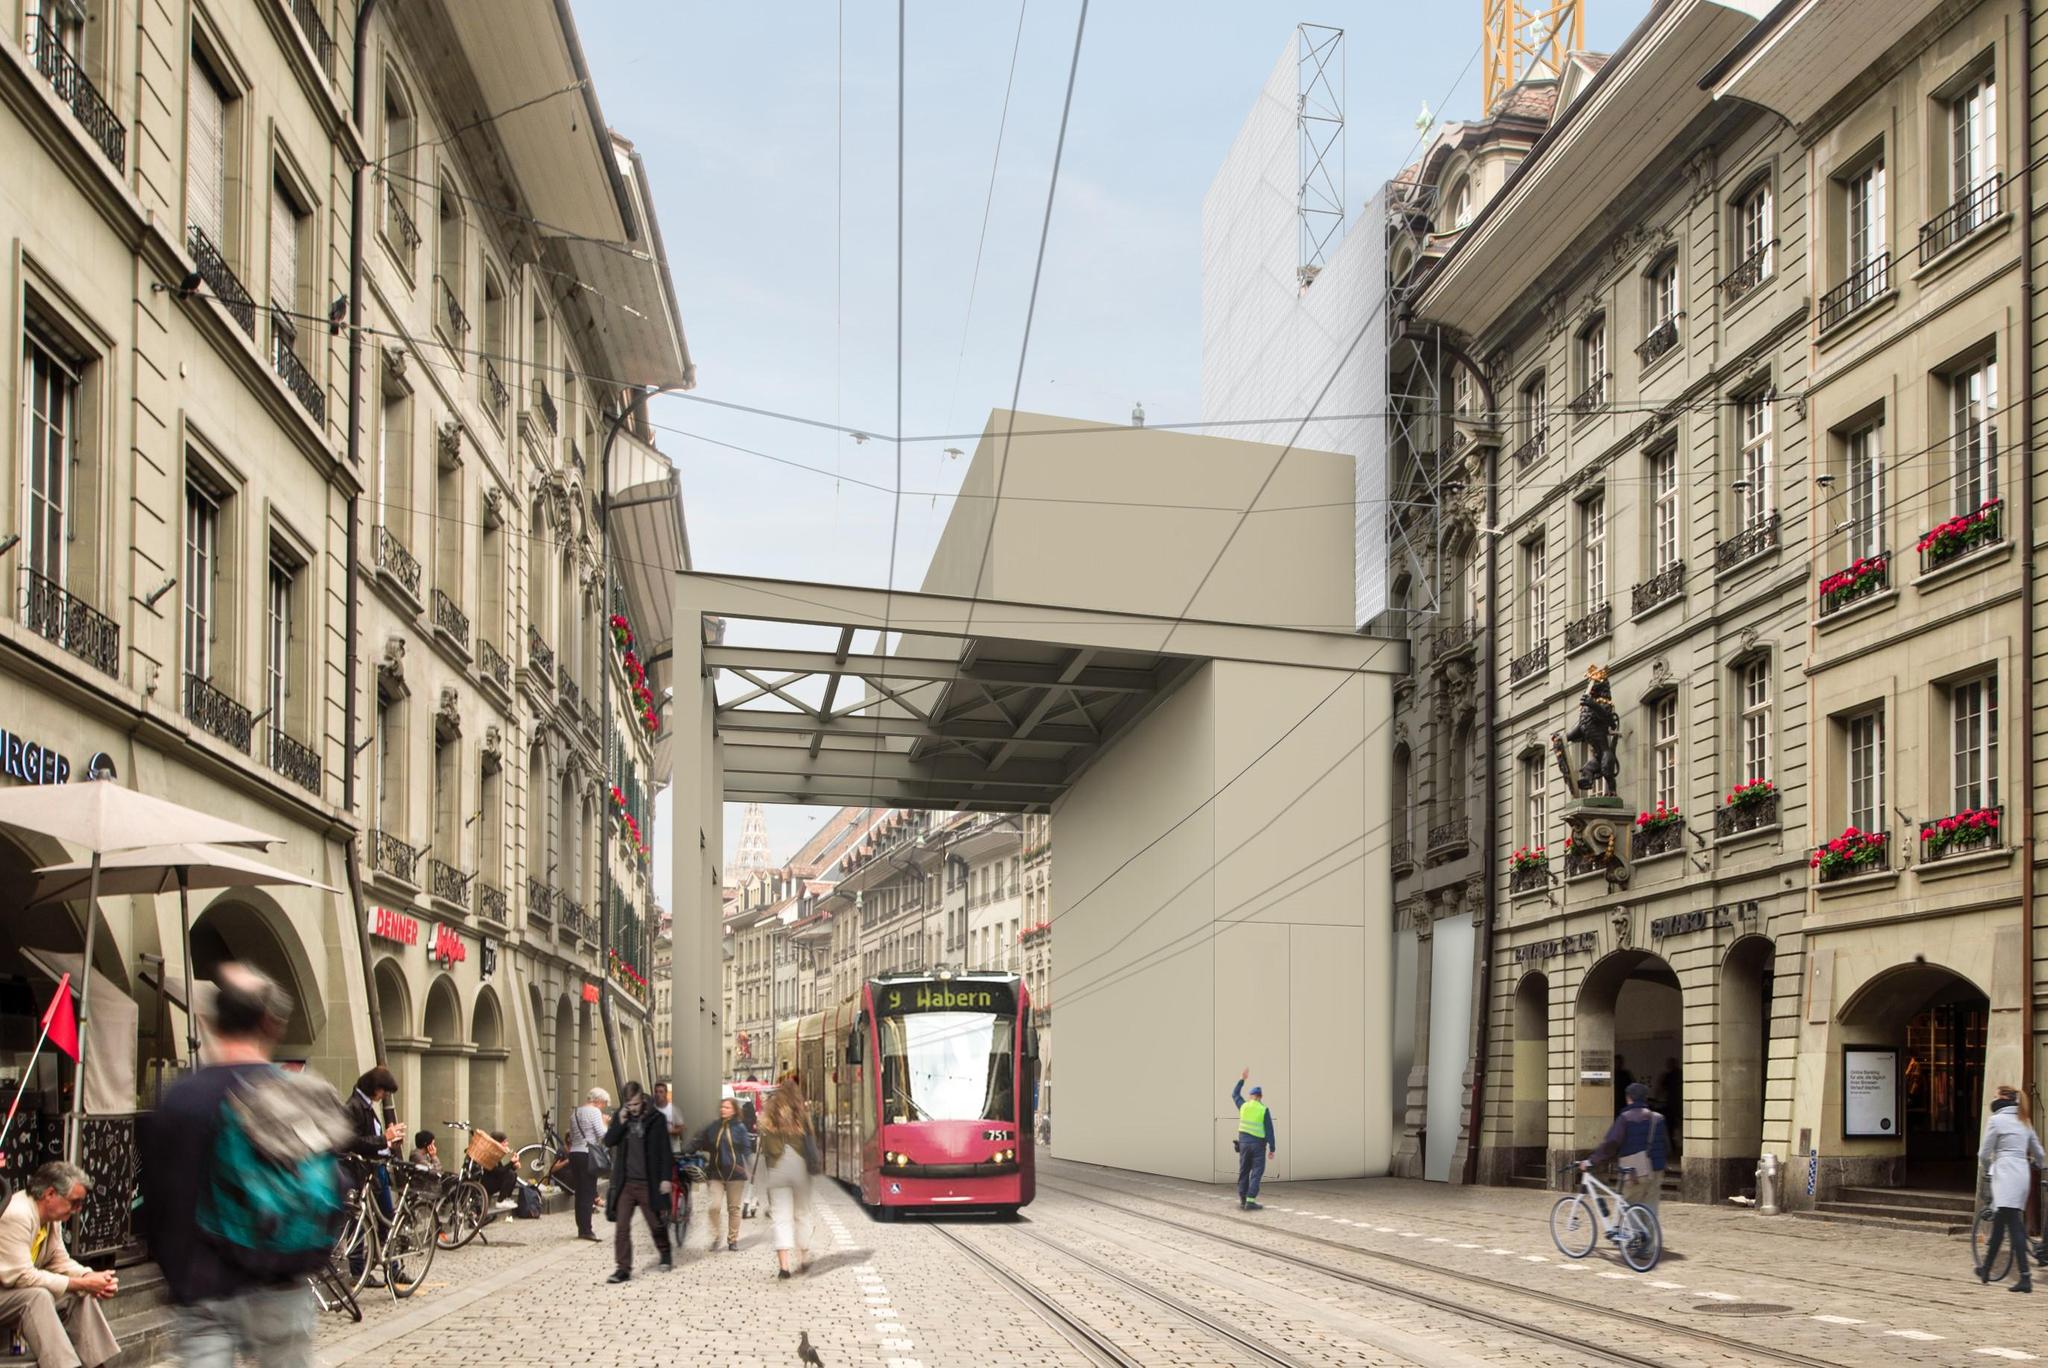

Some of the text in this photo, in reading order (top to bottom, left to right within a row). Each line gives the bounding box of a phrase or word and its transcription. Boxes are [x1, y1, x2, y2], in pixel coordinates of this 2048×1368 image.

[377, 906, 418, 945] DENNER
[889, 988, 991, 1008] 9 Wabern
[988, 1129, 1007, 1141] 751
